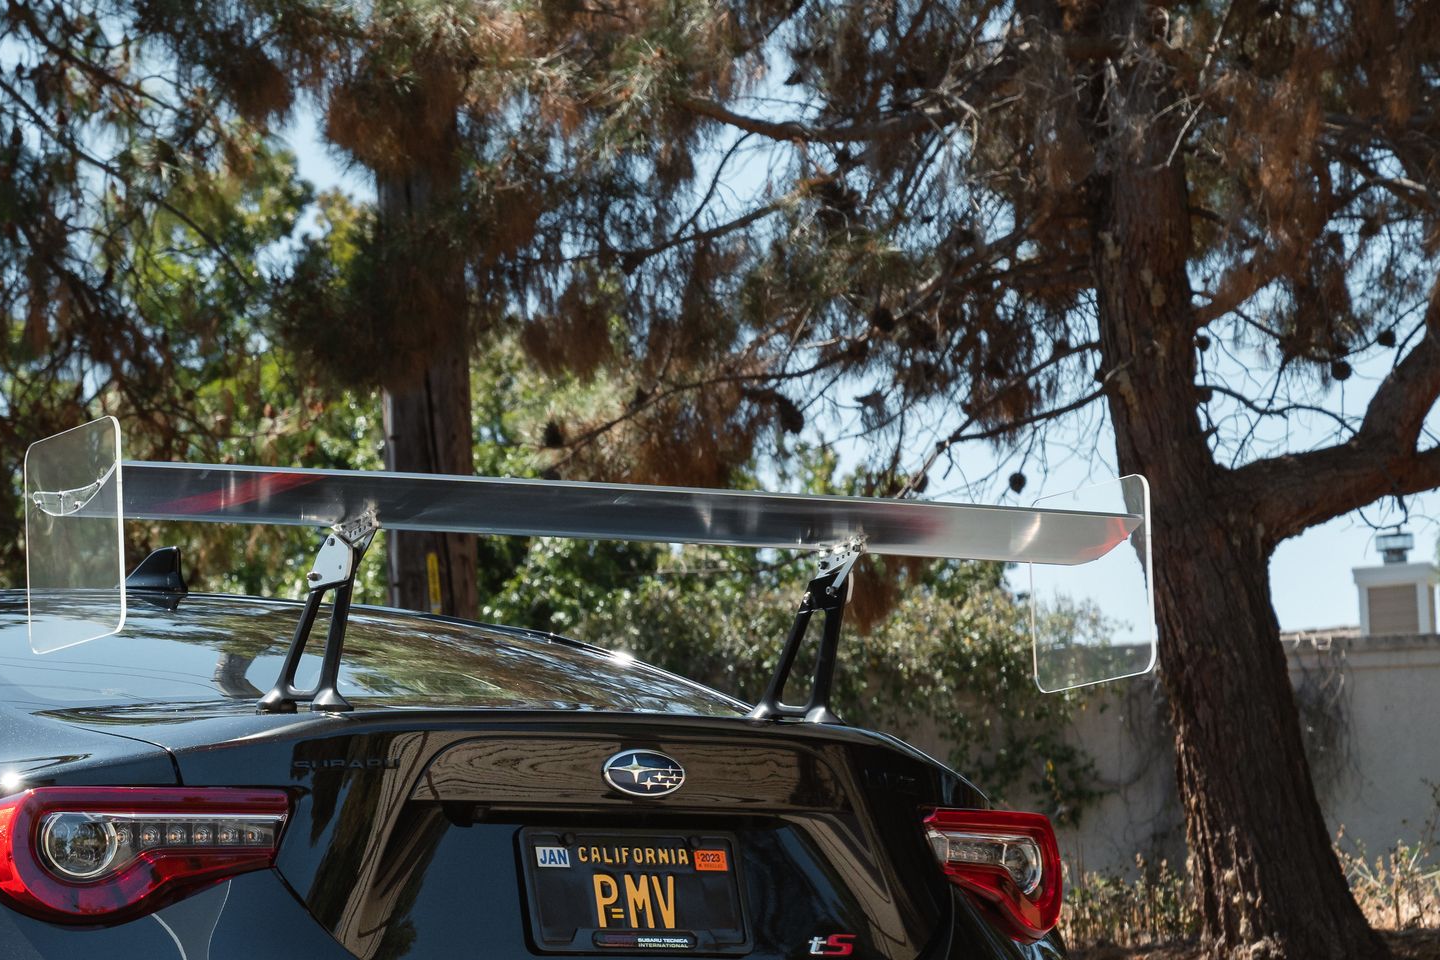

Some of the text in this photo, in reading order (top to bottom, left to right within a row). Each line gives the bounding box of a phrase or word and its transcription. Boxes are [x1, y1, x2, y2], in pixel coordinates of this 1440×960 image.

[540, 848, 568, 865] JAN
[577, 846, 690, 865] CALIFORNIA
[700, 852, 721, 863] 2023
